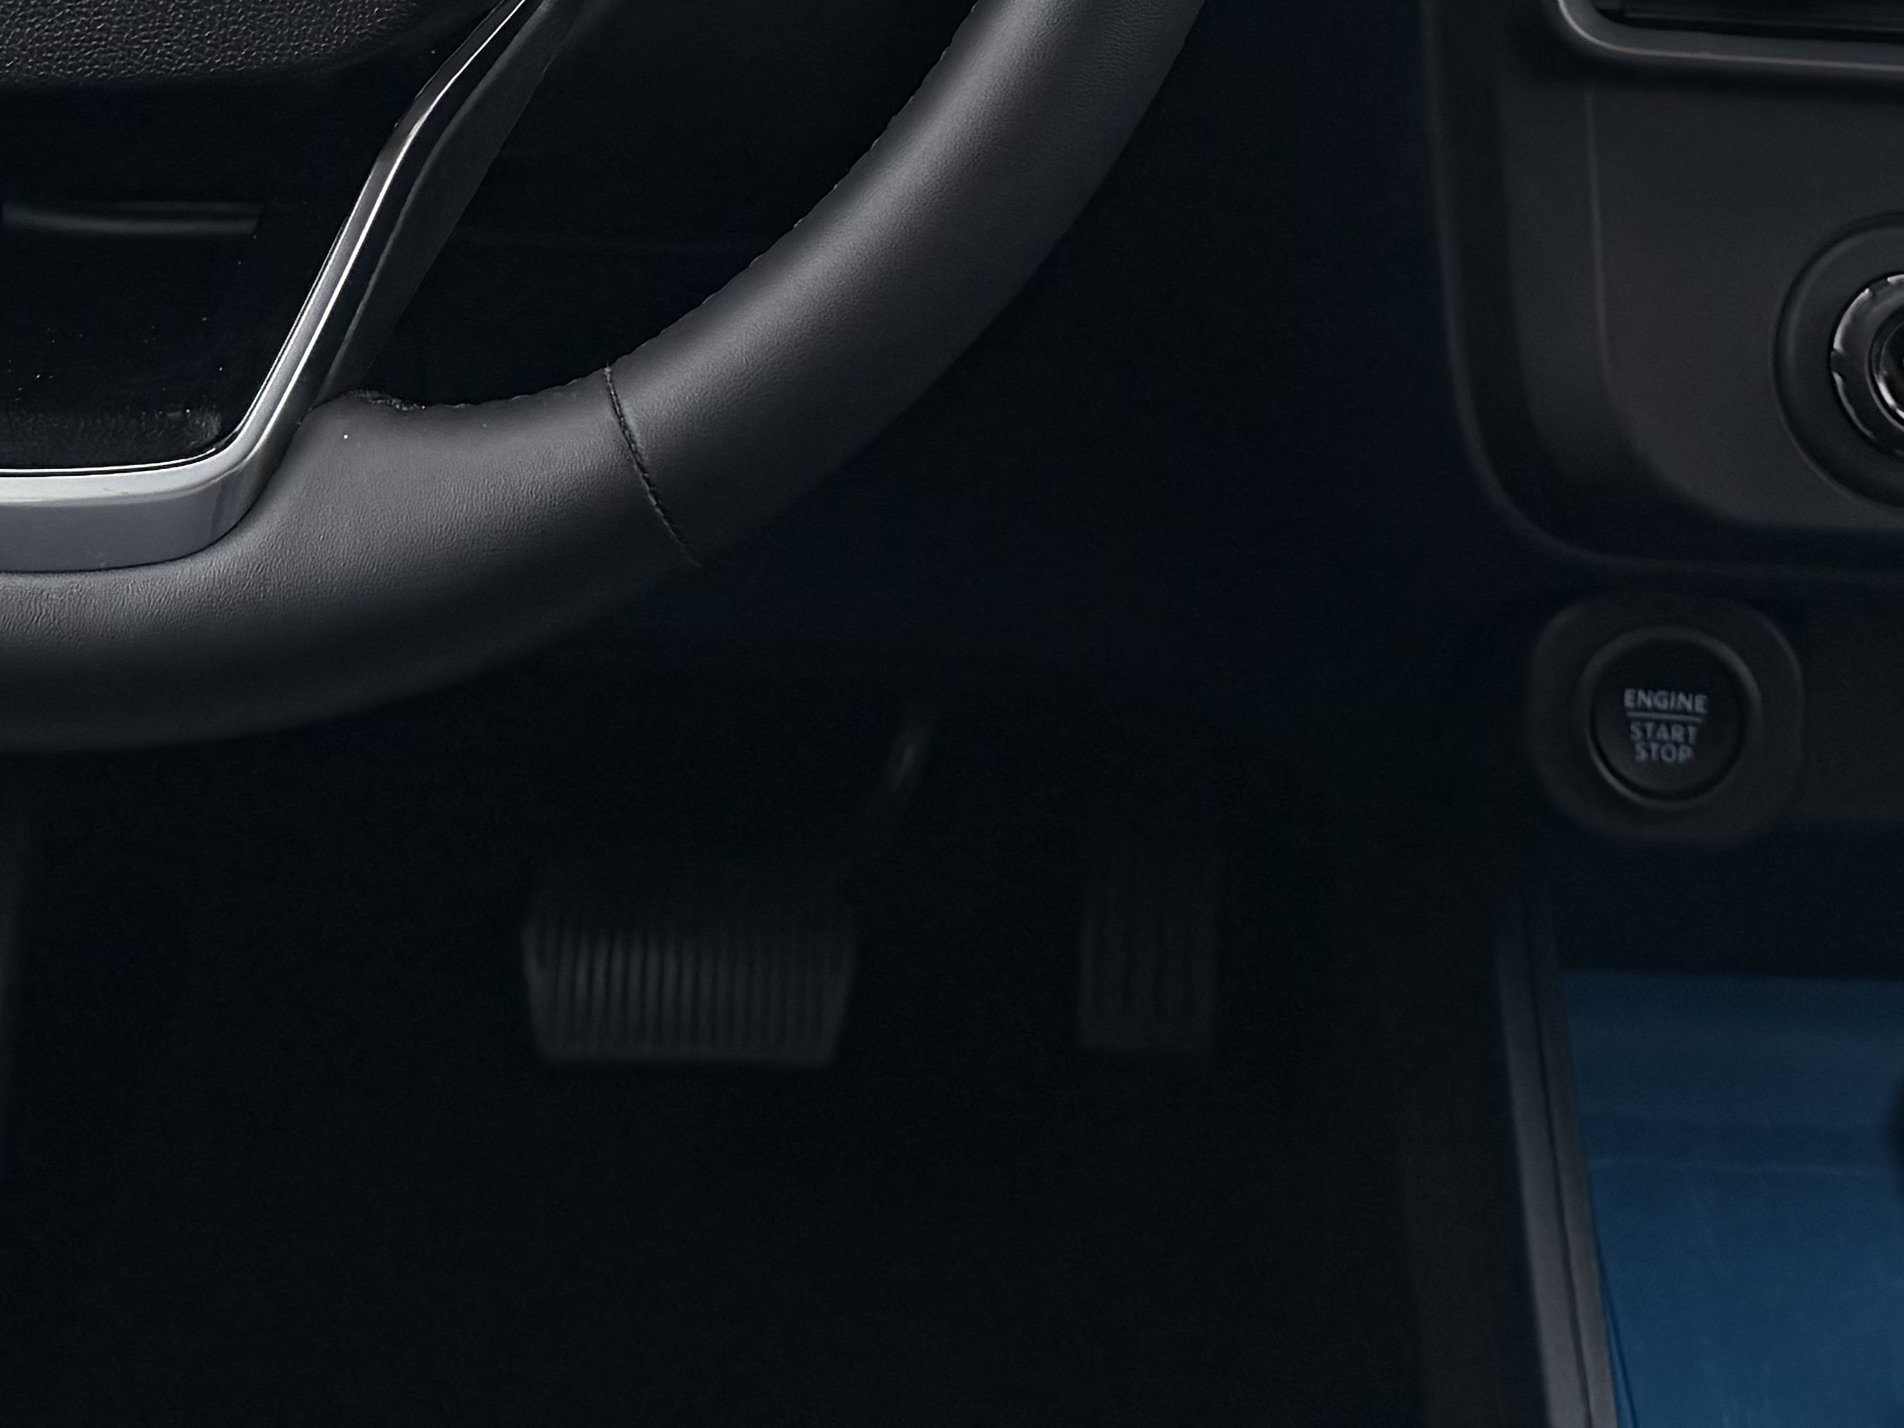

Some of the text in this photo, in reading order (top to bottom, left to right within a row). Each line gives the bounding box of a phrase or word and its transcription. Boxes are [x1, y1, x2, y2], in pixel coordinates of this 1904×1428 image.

[1623, 688, 1709, 714] ENGINE
[1629, 721, 1698, 744] START
[1633, 742, 1693, 764] STOP
